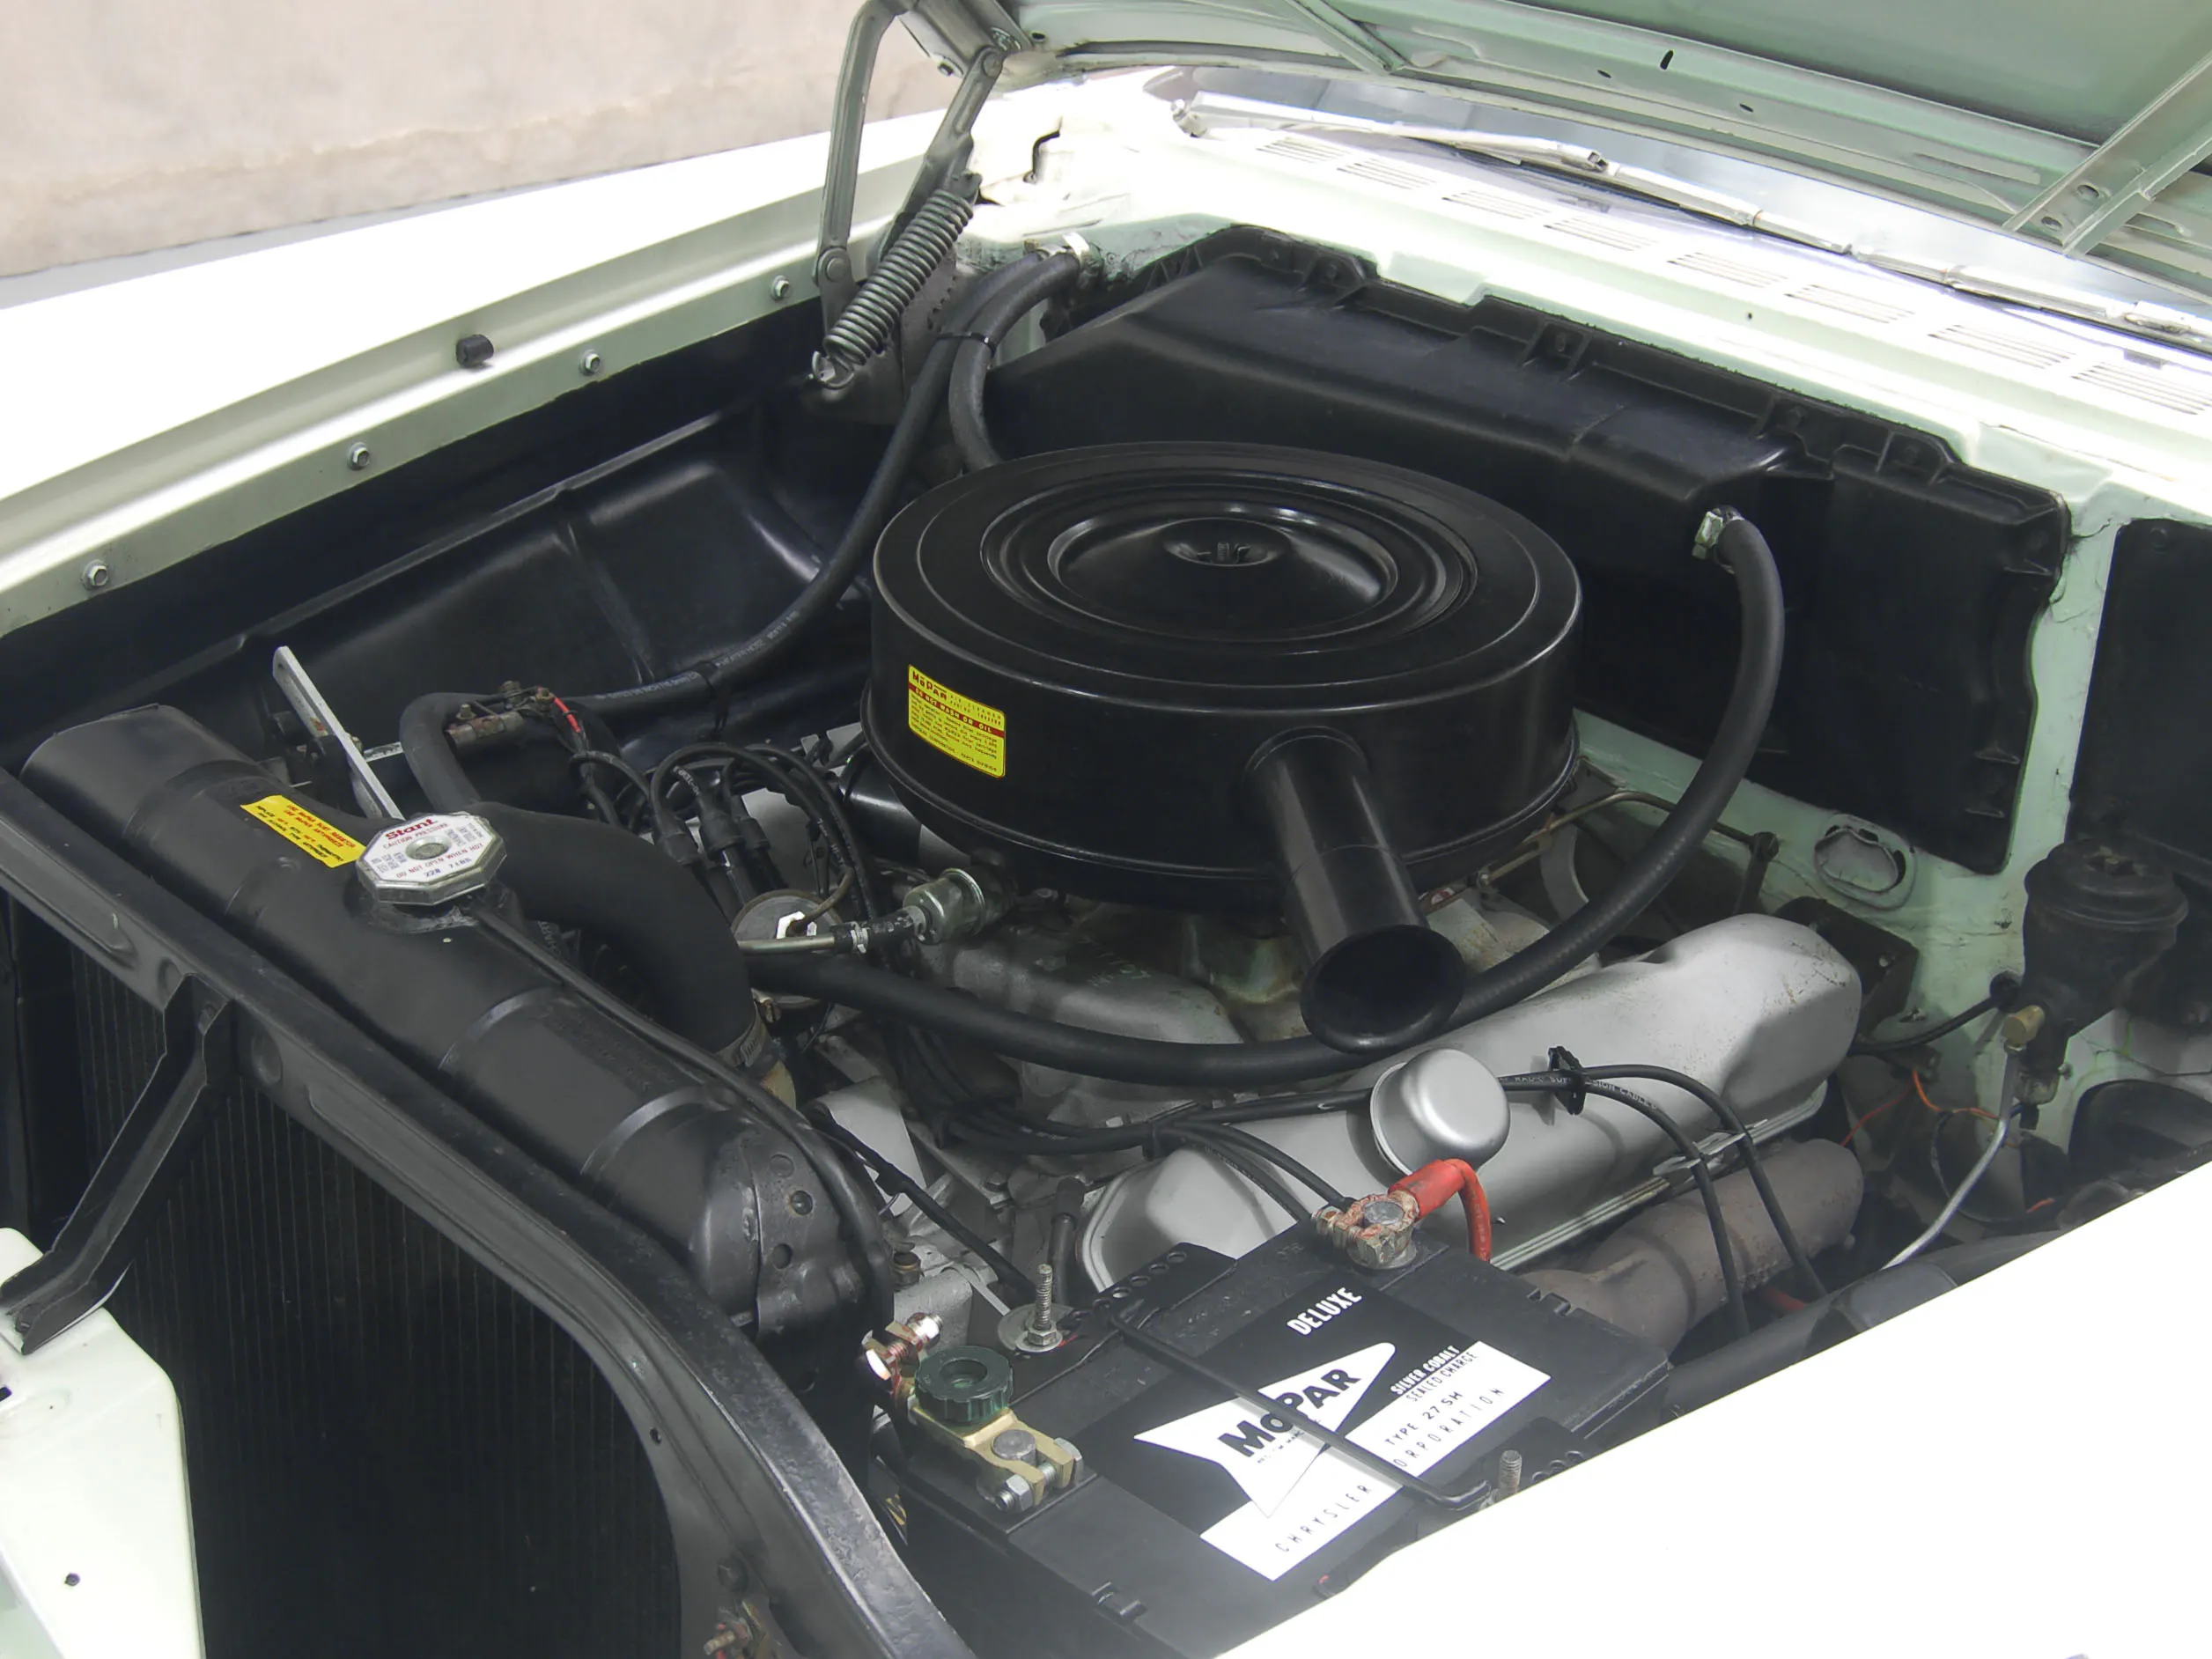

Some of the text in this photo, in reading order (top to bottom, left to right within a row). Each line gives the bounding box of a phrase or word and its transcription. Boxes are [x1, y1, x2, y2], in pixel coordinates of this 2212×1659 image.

[940, 704, 961, 719] WASH
[962, 715, 974, 726] OR
[978, 722, 992, 734] OIL
[383, 835, 413, 850] CAUTION
[385, 818, 435, 840] Stant
[409, 865, 423, 874] NOT
[424, 857, 444, 866] OPEN
[446, 849, 468, 859] WHEN
[1287, 1287, 1362, 1336] DELUXE
[1390, 1345, 1461, 1396] SILVER COBALT
[1406, 1352, 1478, 1403] SEALED CHARGE
[1385, 1422, 1419, 1446] TYPE
[1274, 1485, 1372, 1552] CHRYSLER
[1393, 1387, 1505, 1468] ORPORATION
